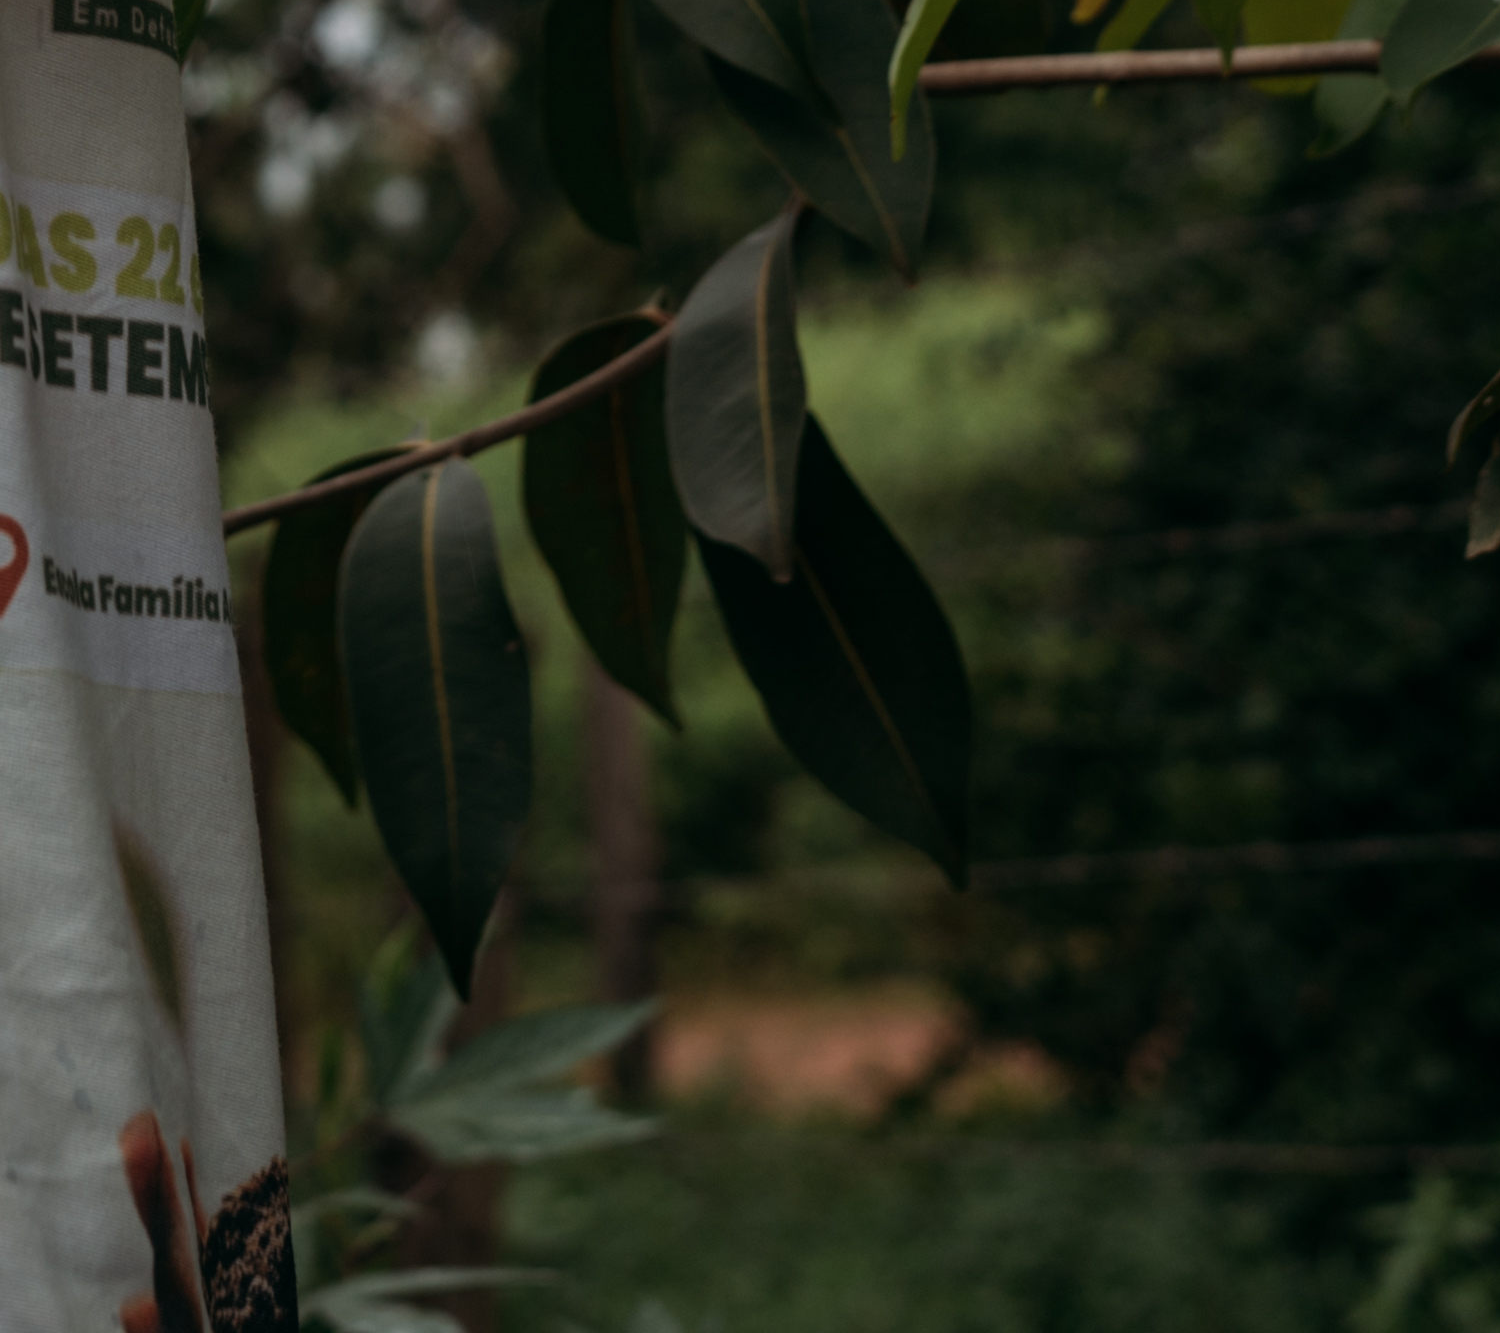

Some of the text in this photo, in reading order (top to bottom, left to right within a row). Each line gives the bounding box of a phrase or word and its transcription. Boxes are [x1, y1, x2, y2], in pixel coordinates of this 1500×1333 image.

[130, 5, 177, 51] Defe
[115, 215, 186, 307] 22
[98, 573, 220, 624] Família
